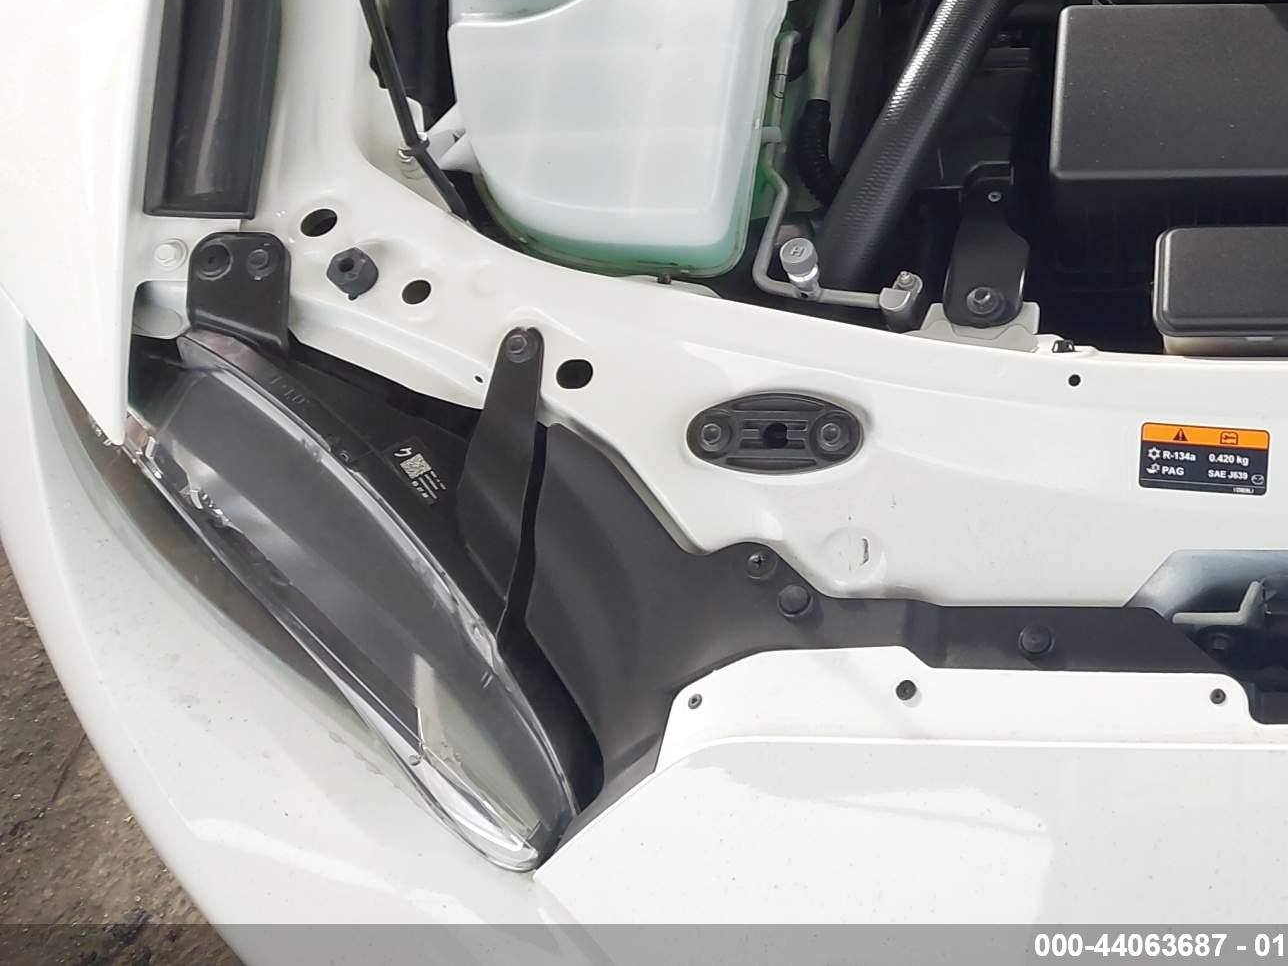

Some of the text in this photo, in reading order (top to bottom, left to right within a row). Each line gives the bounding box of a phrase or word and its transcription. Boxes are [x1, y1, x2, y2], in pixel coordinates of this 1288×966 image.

[1162, 450, 1250, 466] R-134a 0.420 kg
[1161, 466, 1248, 480] PAG SAE J639
